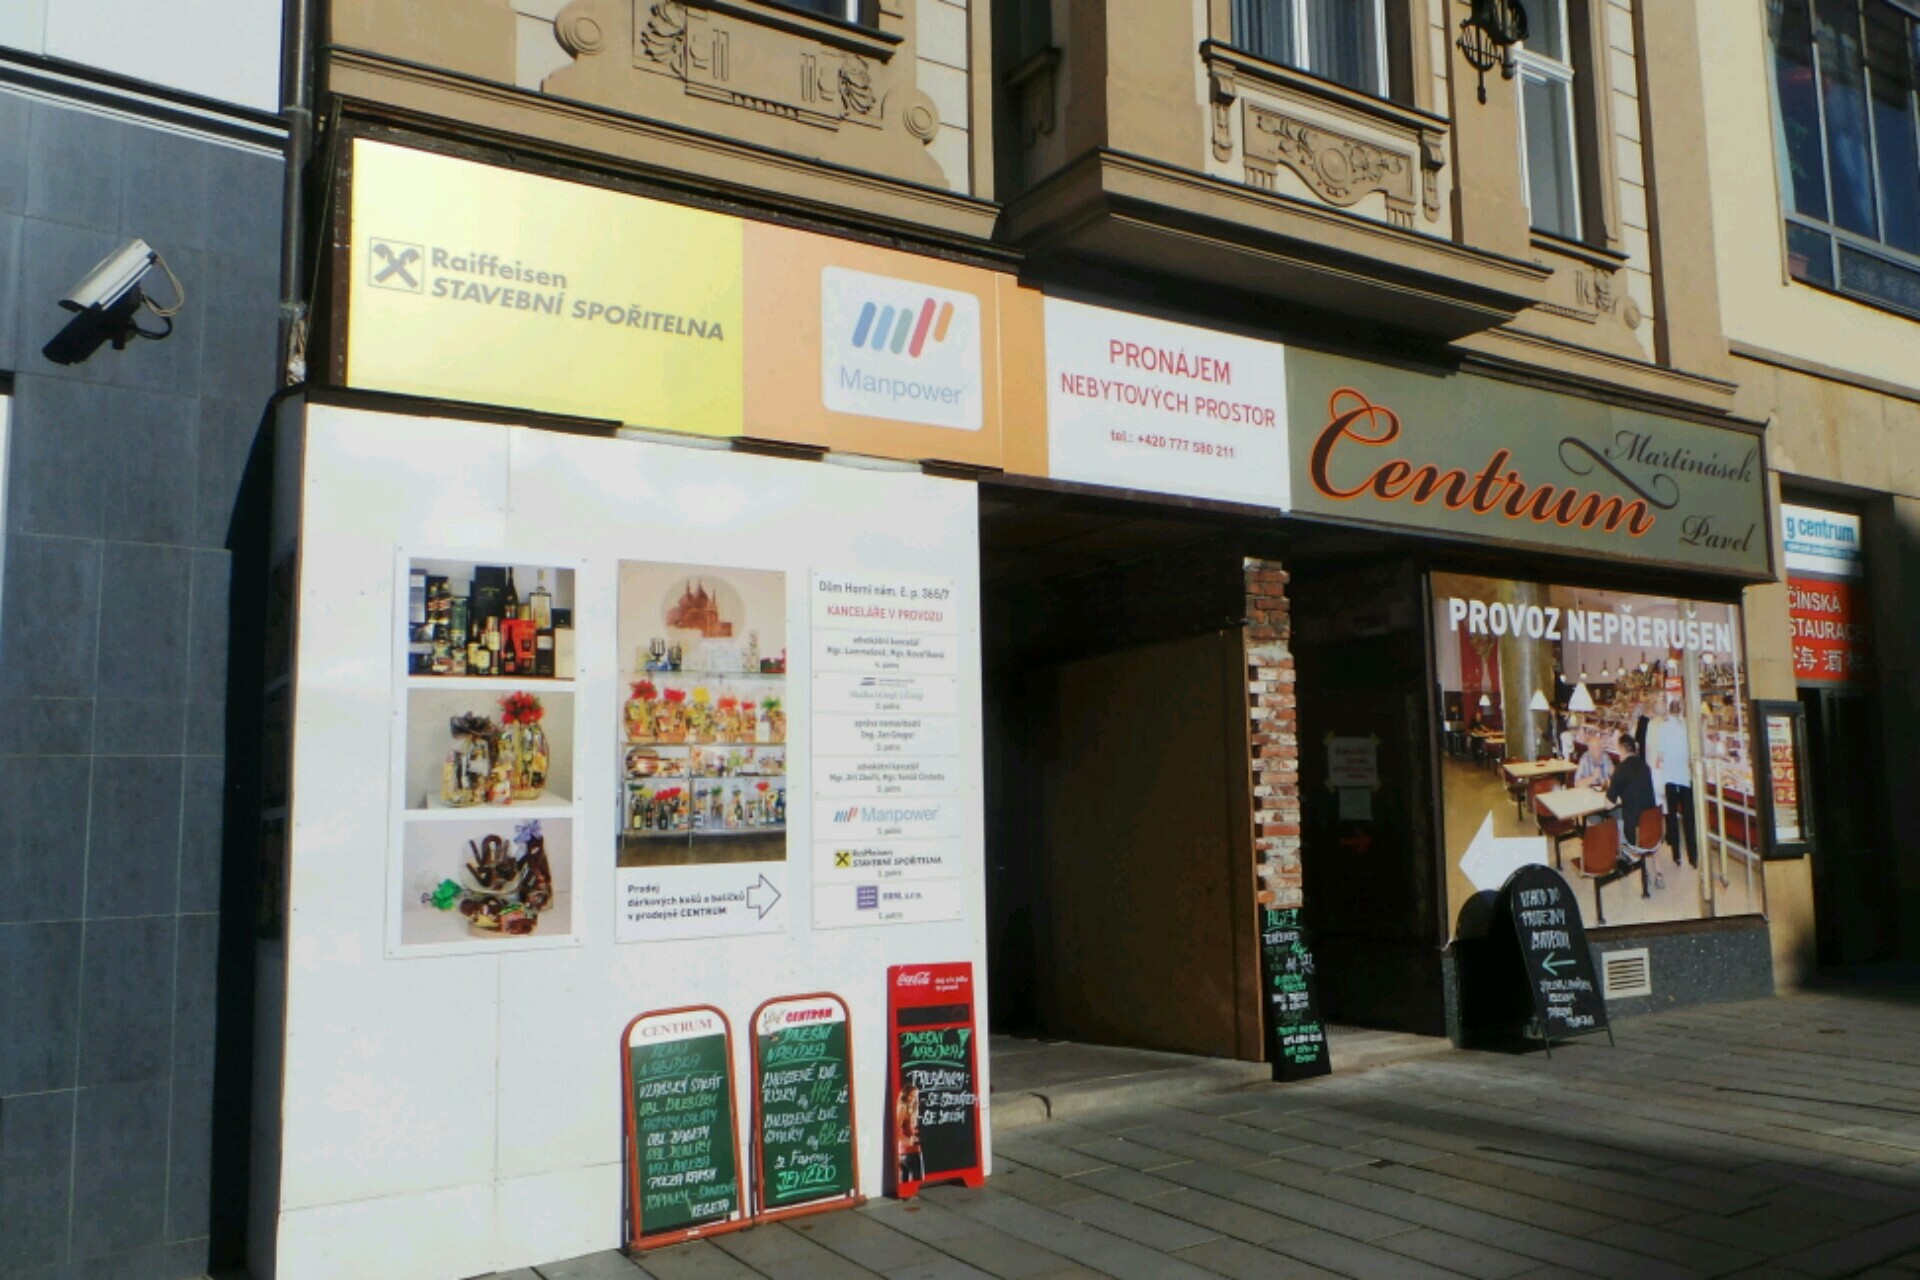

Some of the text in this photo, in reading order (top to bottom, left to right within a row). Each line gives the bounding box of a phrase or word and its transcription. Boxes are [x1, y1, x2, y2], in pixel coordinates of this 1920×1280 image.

[431, 246, 568, 289] Raiffeisen
[431, 276, 725, 342] STAVEBNÍ SPOŘITELNA
[1109, 339, 1232, 386] PRONÁJEM
[840, 365, 963, 405] Manpower
[1061, 372, 1276, 427] NEBYTOVÝCH PROSTOR
[1137, 434, 1166, 447] +420
[1169, 438, 1189, 451] 777
[1216, 446, 1234, 457] 211
[1603, 429, 1758, 484] Martinásek
[1309, 387, 1656, 536] Centrum
[1678, 513, 1758, 553] Pavel
[1799, 517, 1856, 543] centrum
[819, 580, 842, 593] Dům
[844, 583, 872, 595] Horní
[874, 585, 897, 597] nám.
[1788, 586, 1841, 612] ČÍNSKÁ
[827, 605, 943, 622] KANCELÁŘE V PROVOZU
[1449, 597, 1732, 653] PROVOZ NEPŘERUŠEN
[861, 807, 938, 825] Manpower
[627, 884, 660, 895] Prodej
[627, 896, 677, 908] dárkových
[635, 910, 678, 922] prodejně
[680, 906, 727, 918] CENTRUM
[642, 1018, 713, 1038] CENTRUM
